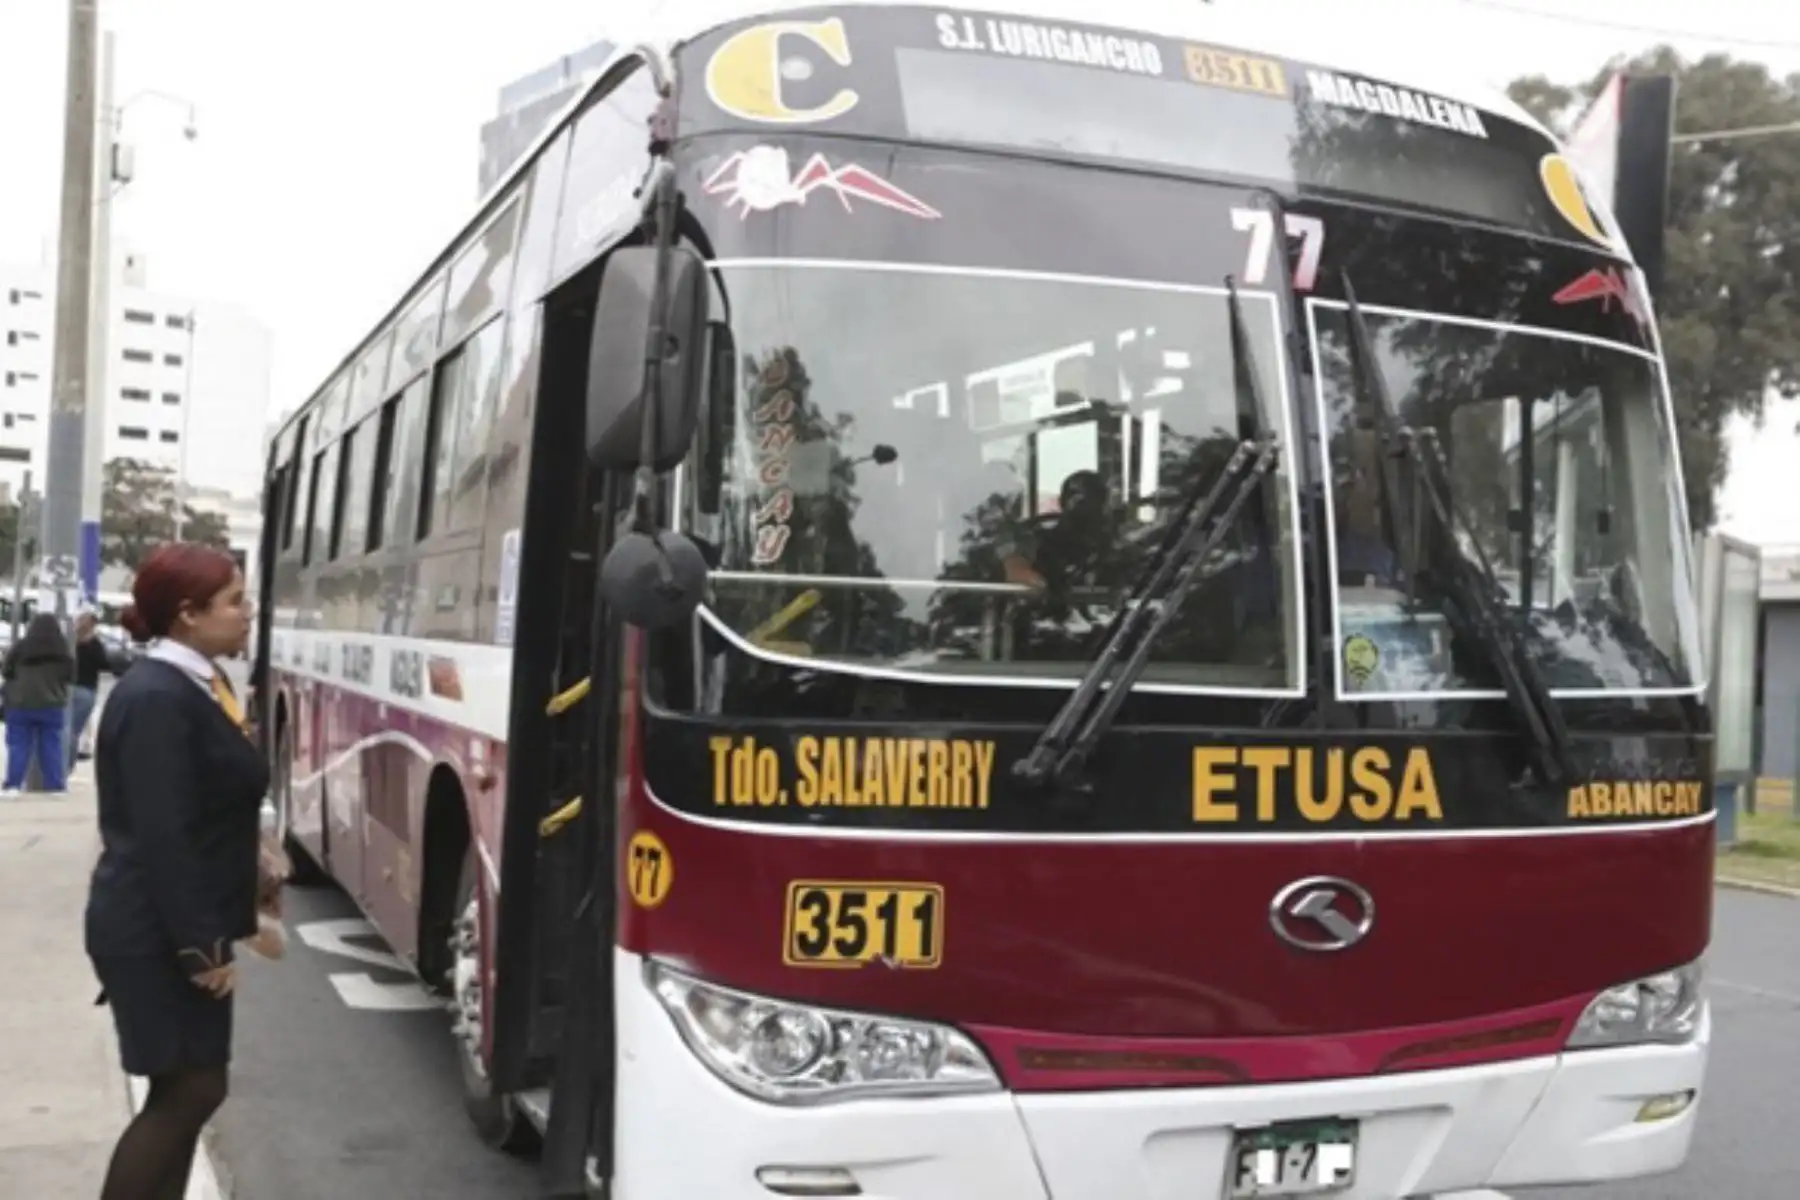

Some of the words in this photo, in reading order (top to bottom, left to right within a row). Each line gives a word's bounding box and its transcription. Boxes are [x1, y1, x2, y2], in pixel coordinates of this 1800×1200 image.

[986, 18, 1164, 76] LURIGANCHO
[1191, 50, 1276, 90] 3511
[1305, 69, 1488, 139] MAGDALENA
[709, 736, 787, 806] Tdo.
[795, 736, 996, 809] SALAVERRY
[1191, 746, 1443, 822] ETUSA
[1567, 781, 1702, 818] ABANCAY
[631, 846, 662, 899] 77
[794, 888, 936, 960] 3511
